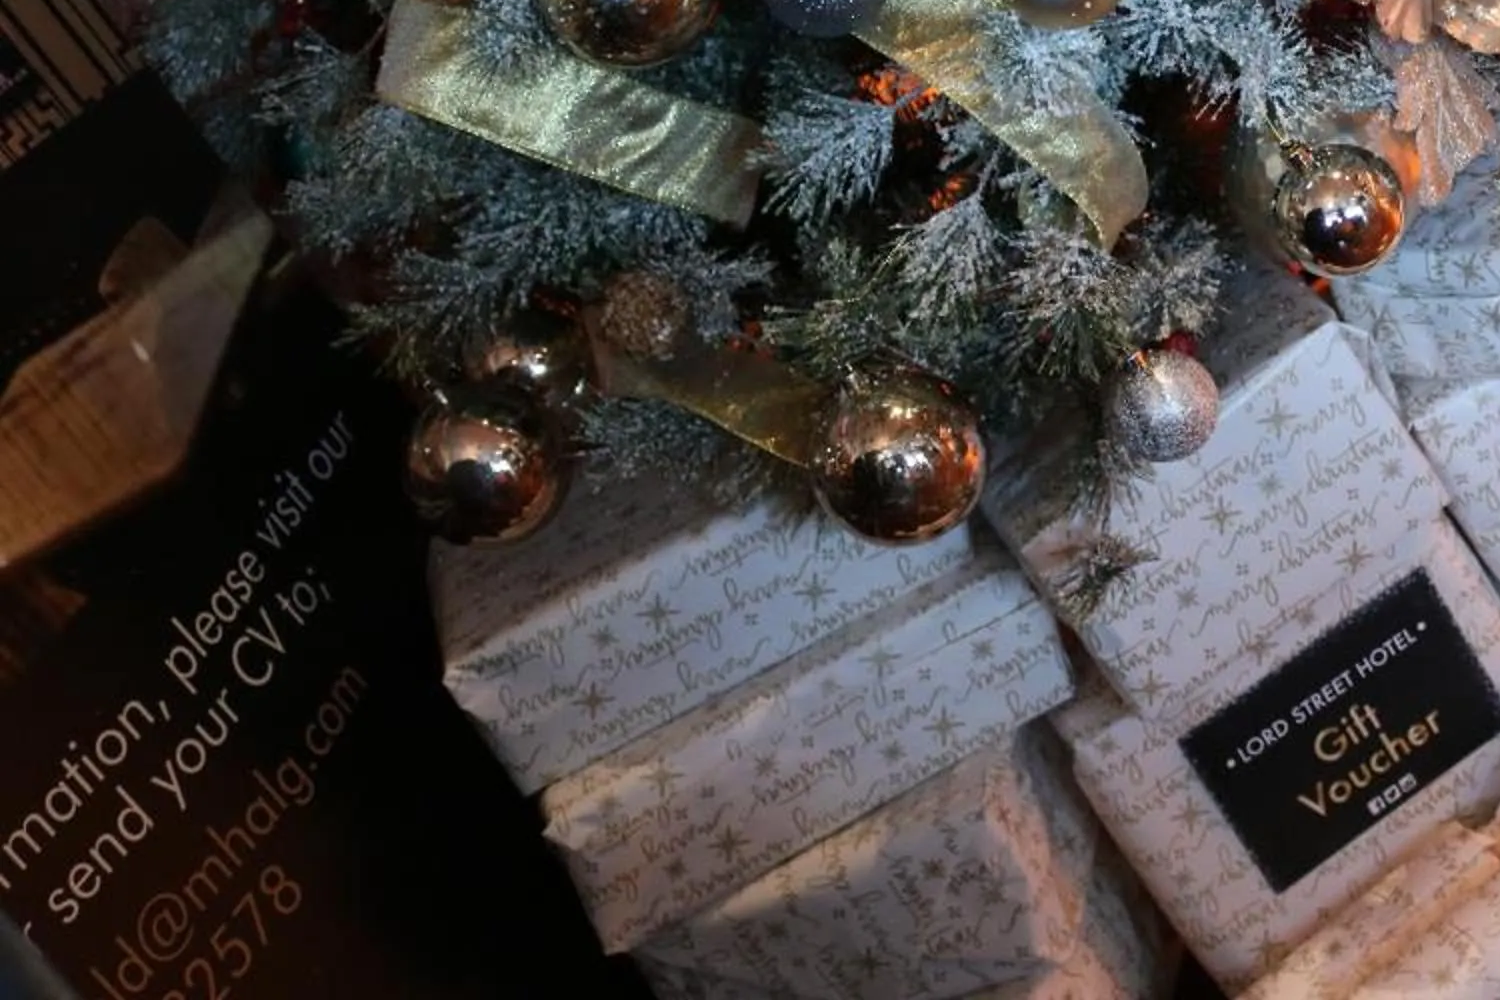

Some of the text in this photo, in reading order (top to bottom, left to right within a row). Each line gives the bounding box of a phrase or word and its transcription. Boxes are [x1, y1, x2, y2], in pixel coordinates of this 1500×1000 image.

[165, 550, 265, 694] please
[256, 471, 316, 551] visit
[308, 410, 355, 480] our
[48, 565, 333, 925] send your CV to;
[1237, 717, 1290, 763] LORD
[1294, 670, 1353, 725] STREET
[1355, 628, 1417, 679] HOTEL
[1314, 703, 1383, 762] Gift
[1297, 709, 1442, 818] Voucher
[166, 866, 302, 1000] 2578
